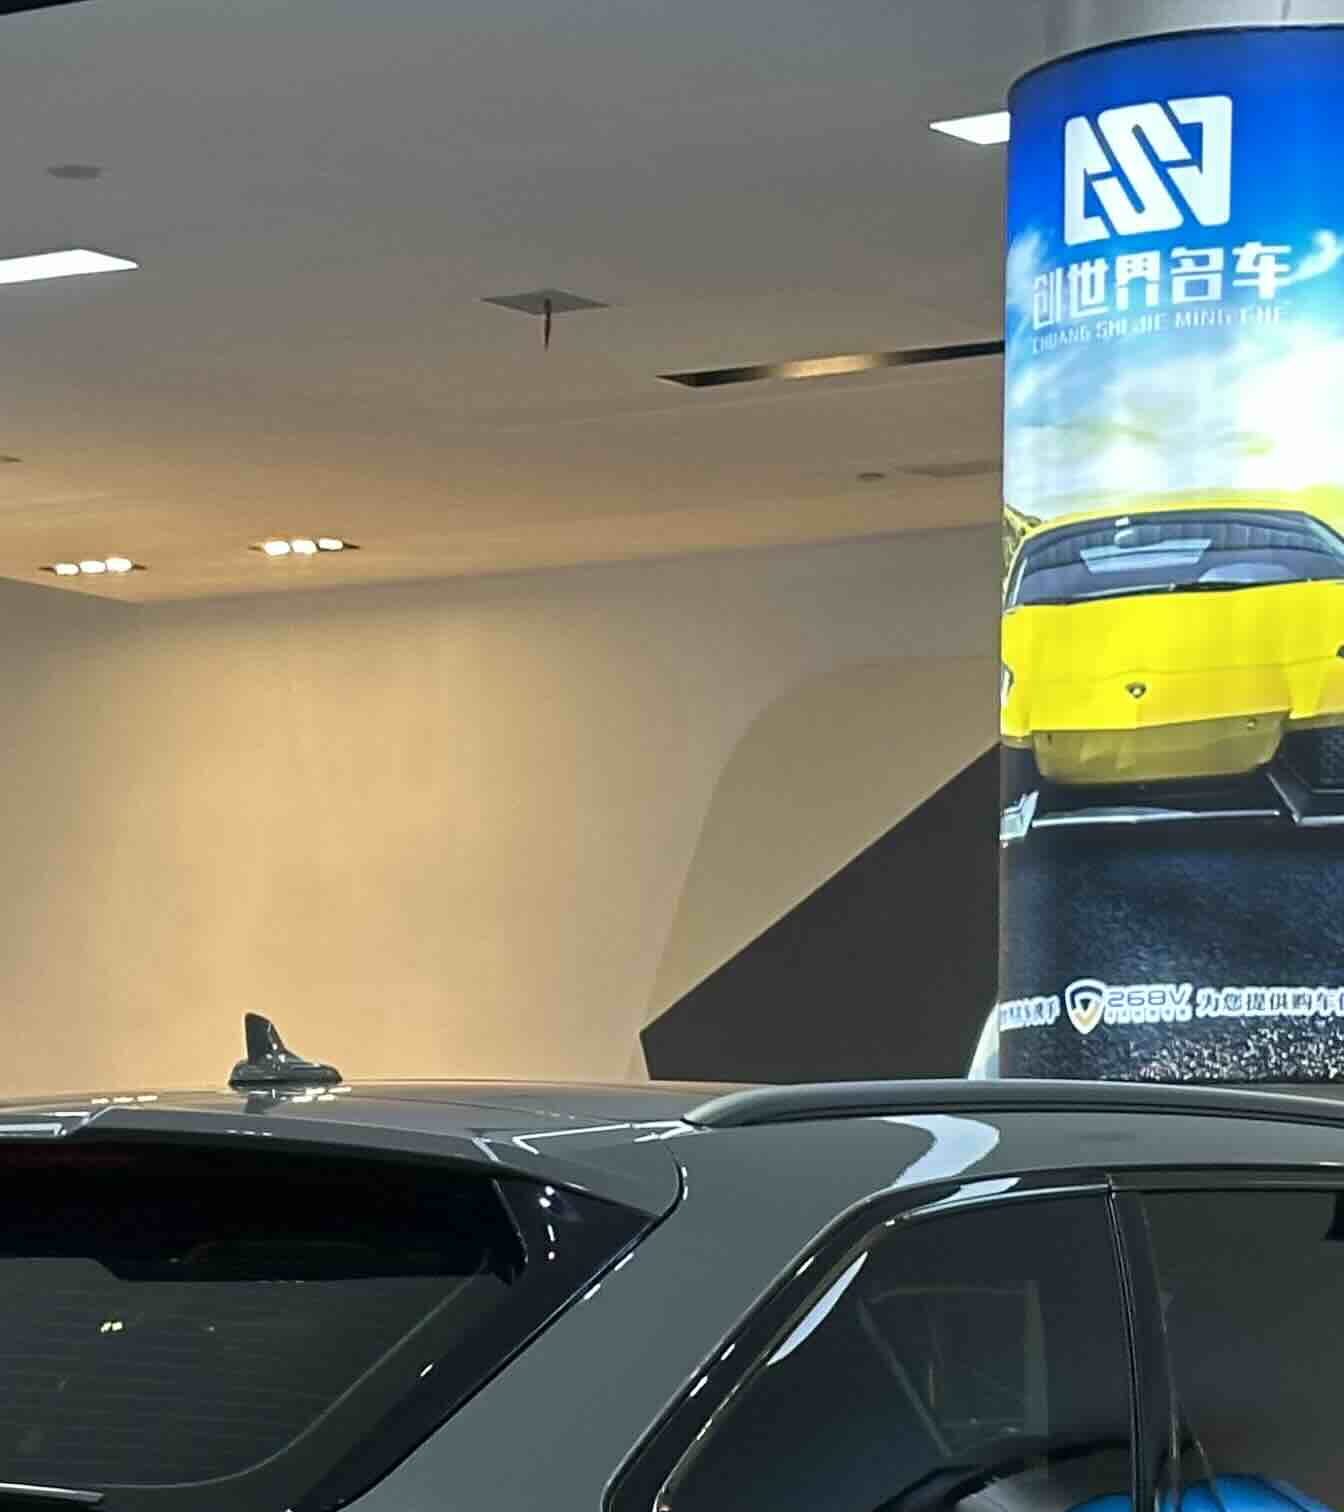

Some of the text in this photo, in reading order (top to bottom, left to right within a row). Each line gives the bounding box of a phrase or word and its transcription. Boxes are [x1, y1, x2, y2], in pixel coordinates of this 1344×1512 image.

[1032, 241, 1292, 331] 创世界名车
[1106, 987, 1192, 1008] 268V
